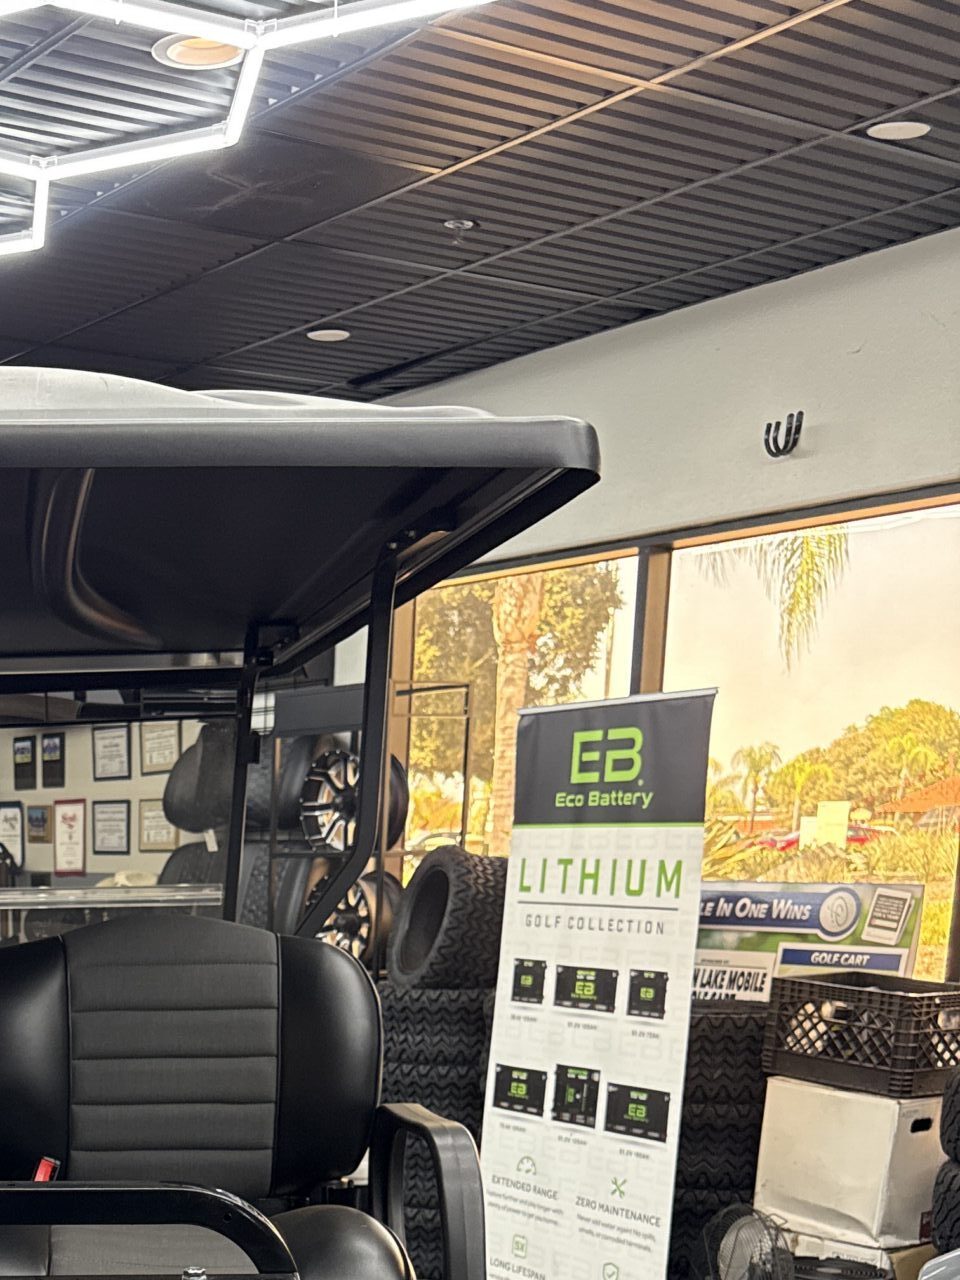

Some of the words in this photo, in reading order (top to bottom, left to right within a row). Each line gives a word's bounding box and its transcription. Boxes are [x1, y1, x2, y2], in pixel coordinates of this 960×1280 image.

[571, 727, 643, 783] EB
[555, 792, 584, 807] Eco
[588, 790, 655, 809] Battery
[518, 857, 683, 899] LITHIUM
[525, 914, 561, 929] GOLF
[567, 916, 664, 935] COLLECTION
[811, 952, 839, 964] GOLF
[840, 953, 870, 966] CART
[700, 968, 727, 989] LAKE
[726, 970, 767, 992] MOBILE
[492, 1174, 532, 1193] EXTENDED
[533, 1185, 559, 1200] RANGE
[576, 1196, 597, 1210] ZERO
[598, 1203, 662, 1228] MAINTENANCE
[490, 1256, 511, 1271] LONG
